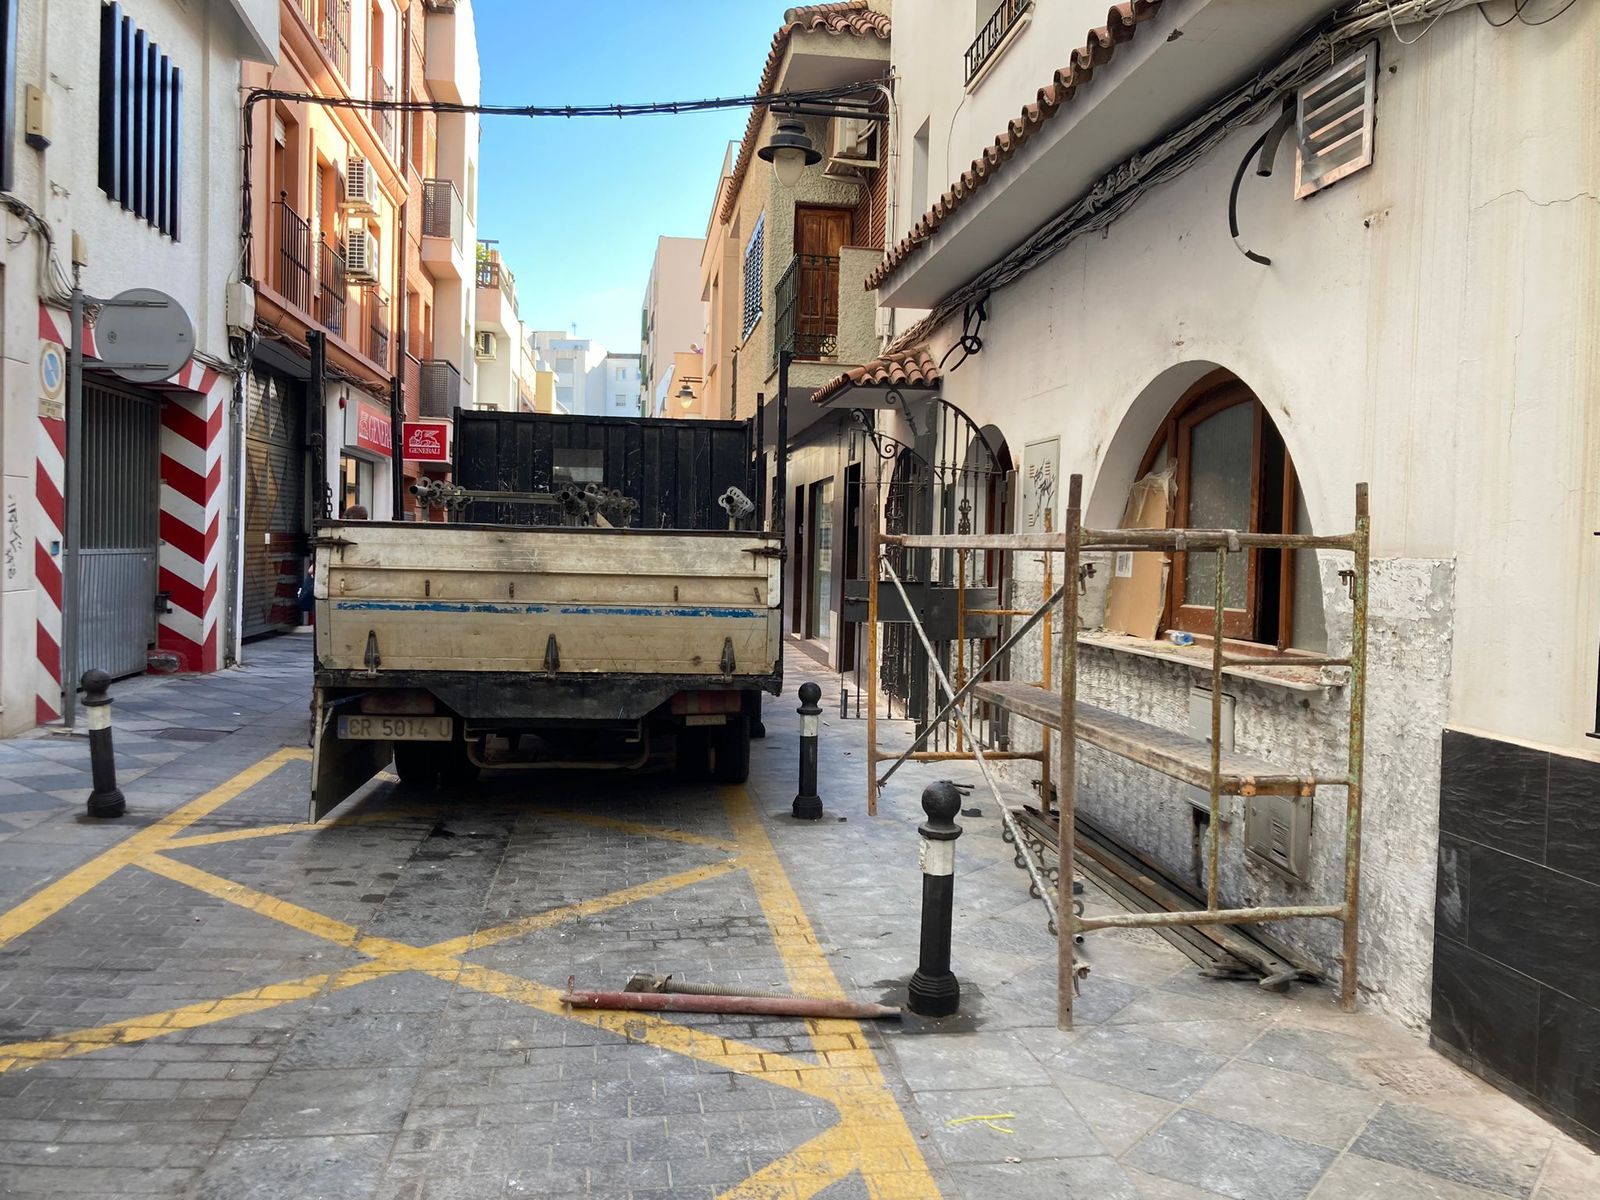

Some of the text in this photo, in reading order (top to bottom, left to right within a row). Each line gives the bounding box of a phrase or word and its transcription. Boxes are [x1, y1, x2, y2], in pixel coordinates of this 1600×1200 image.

[368, 415, 392, 449] GENERA
[349, 718, 372, 736] CR
[382, 719, 428, 737] 5014
[439, 720, 450, 738] U
